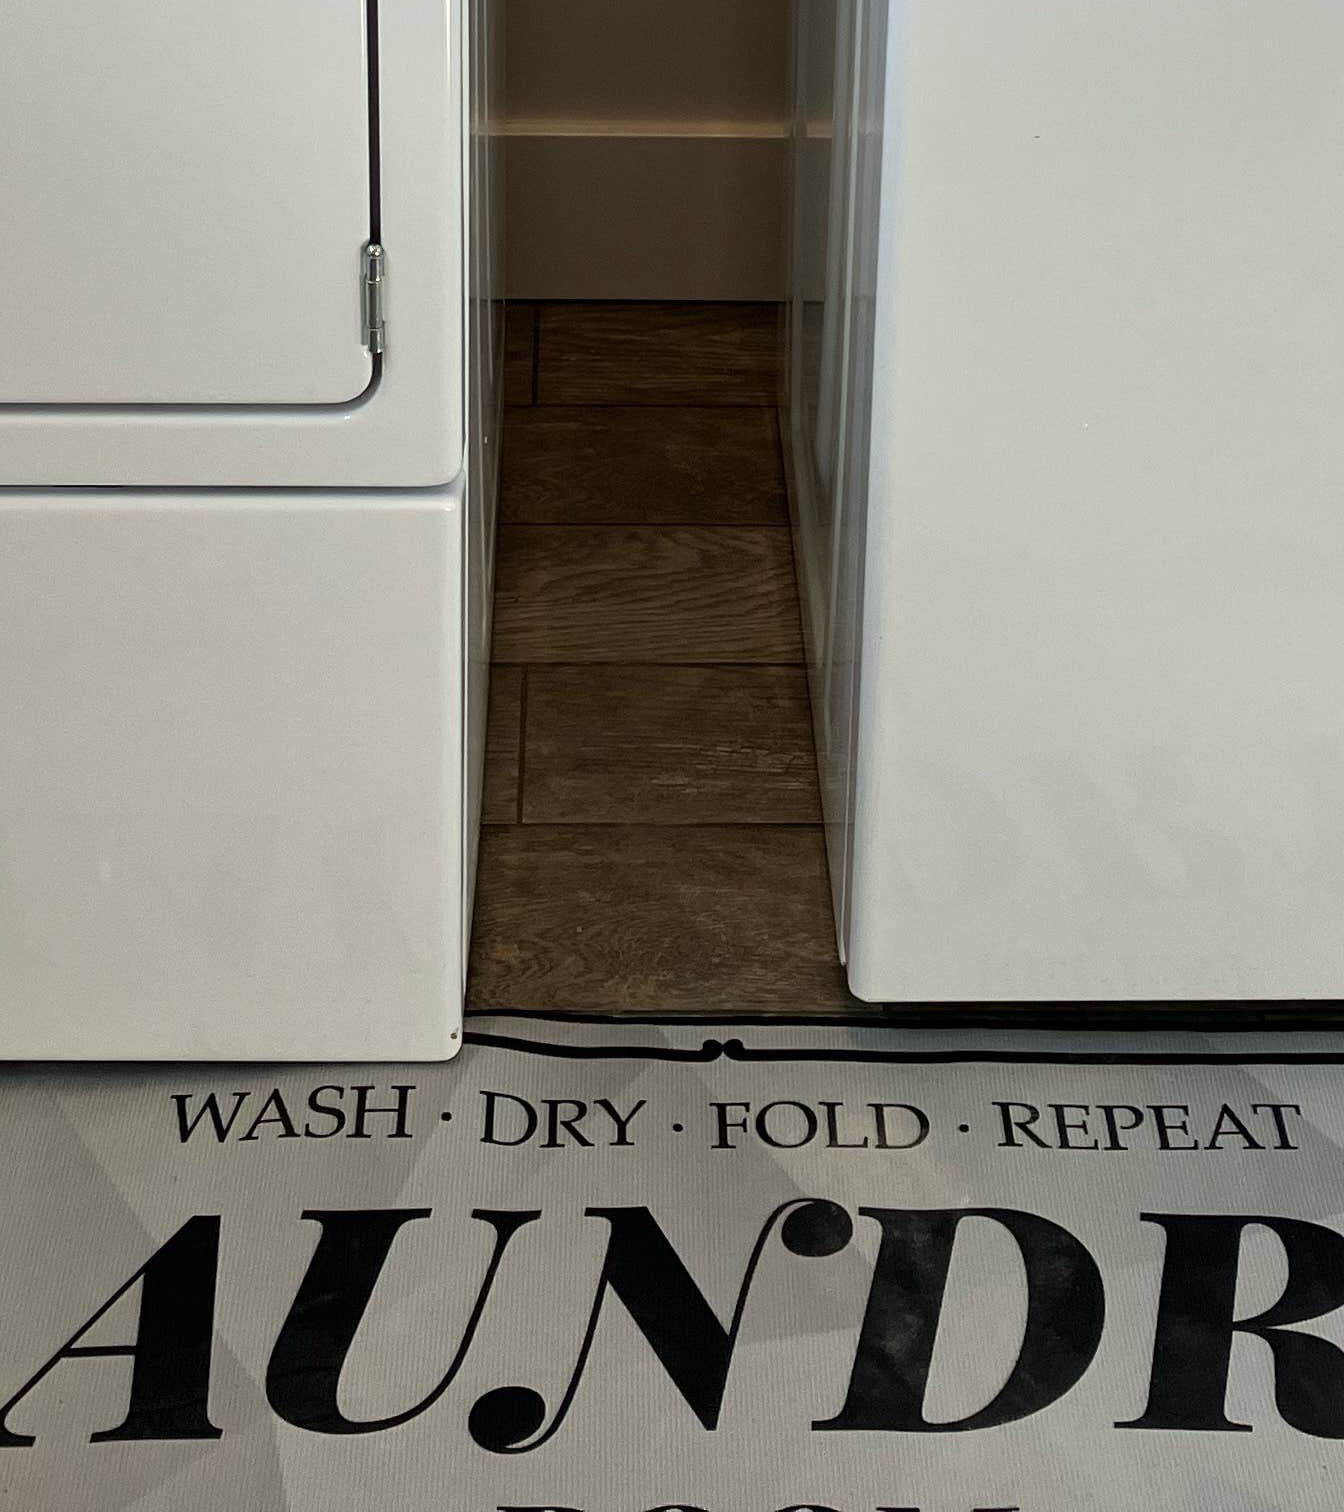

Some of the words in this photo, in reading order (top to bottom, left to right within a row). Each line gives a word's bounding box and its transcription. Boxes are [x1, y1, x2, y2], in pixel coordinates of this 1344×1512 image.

[168, 1089, 419, 1146] WASH
[478, 1093, 642, 1154] DRY
[710, 1097, 929, 1156] FOLD
[997, 1102, 1301, 1159] REPEAT
